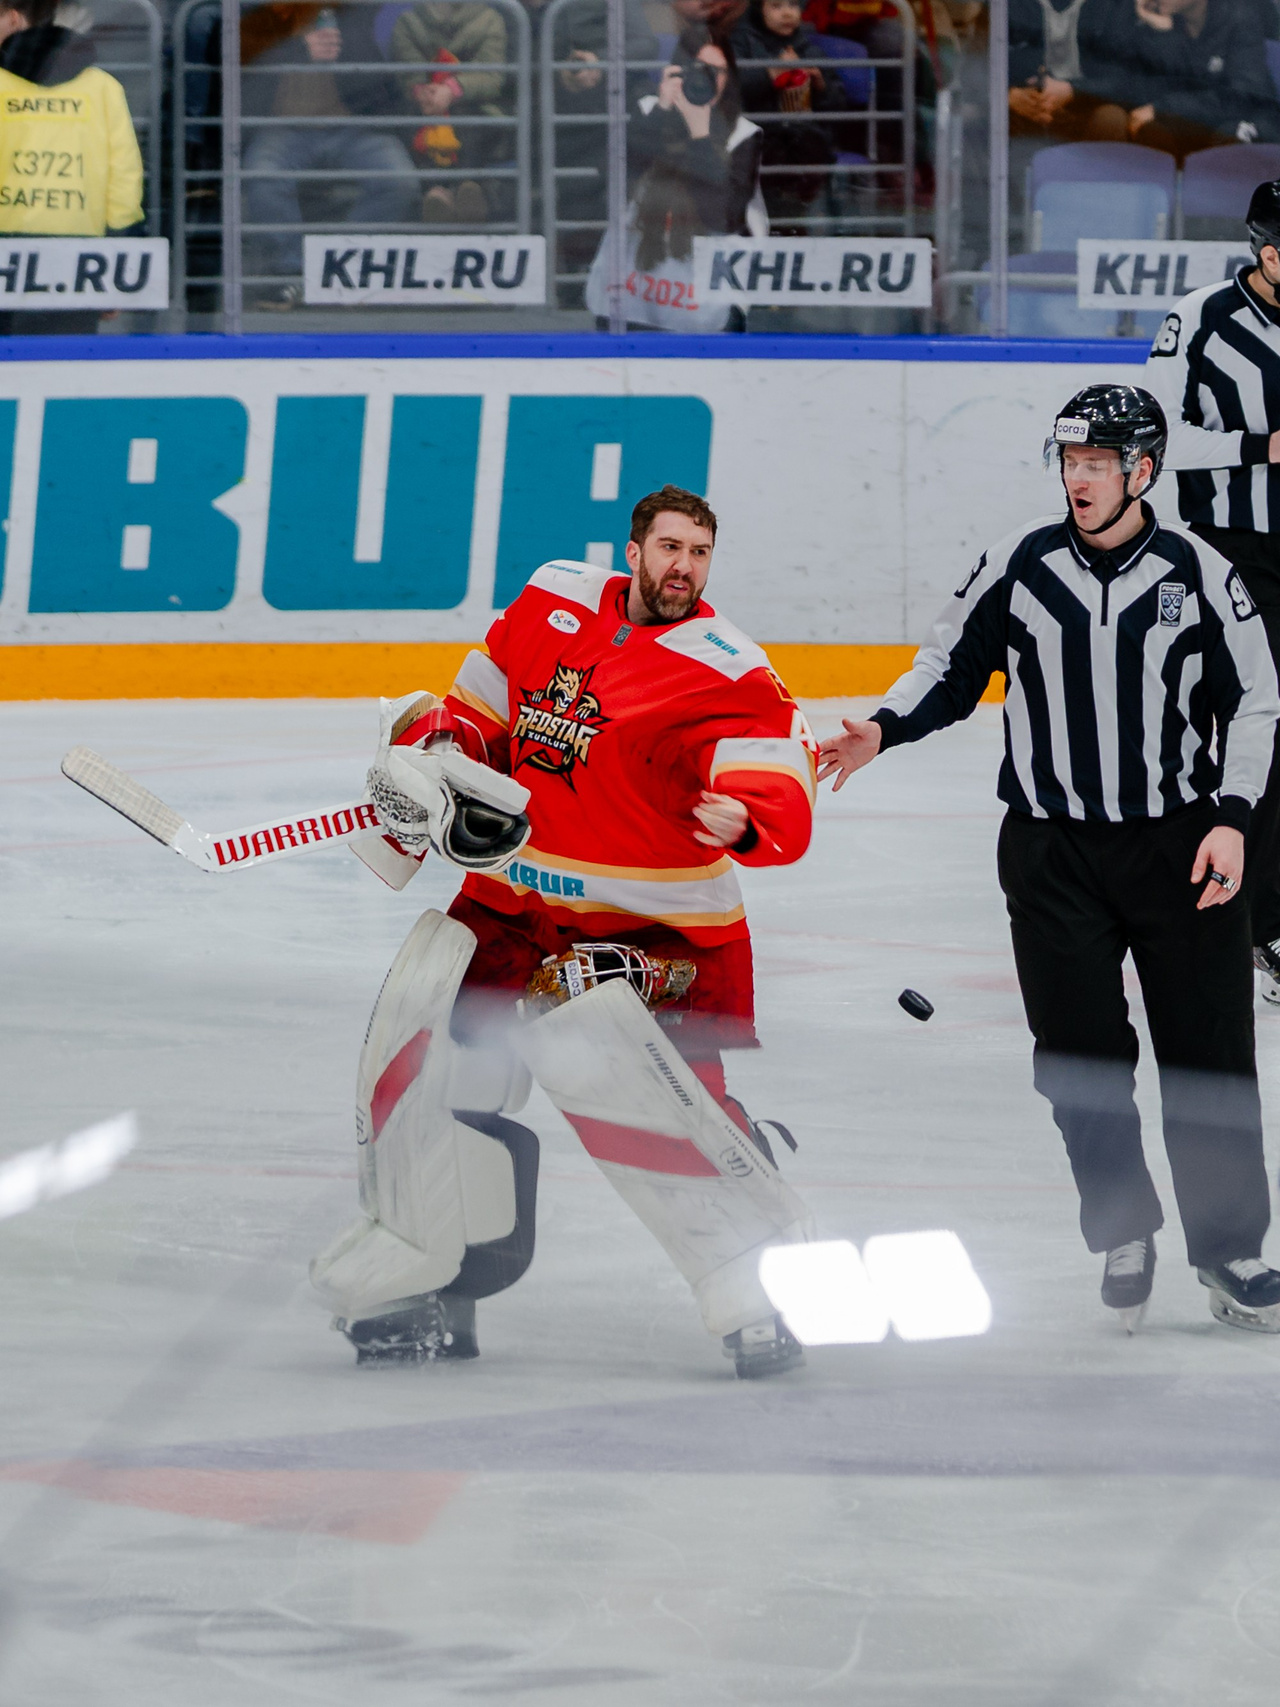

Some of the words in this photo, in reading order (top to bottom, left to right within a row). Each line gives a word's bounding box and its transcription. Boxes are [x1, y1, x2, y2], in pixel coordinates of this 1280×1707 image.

[7, 98, 82, 113] SAFETY
[0, 186, 87, 210] SAFETY
[0, 252, 152, 293] HL.RU
[320, 249, 528, 290] KHL.RU
[709, 251, 916, 293] KHL.RU
[1057, 424, 1086, 435] согаз
[0, 395, 714, 613] BUR
[213, 803, 382, 866] WARRIOR
[503, 861, 586, 898] IBUR
[644, 1041, 694, 1108] WARRIOR
